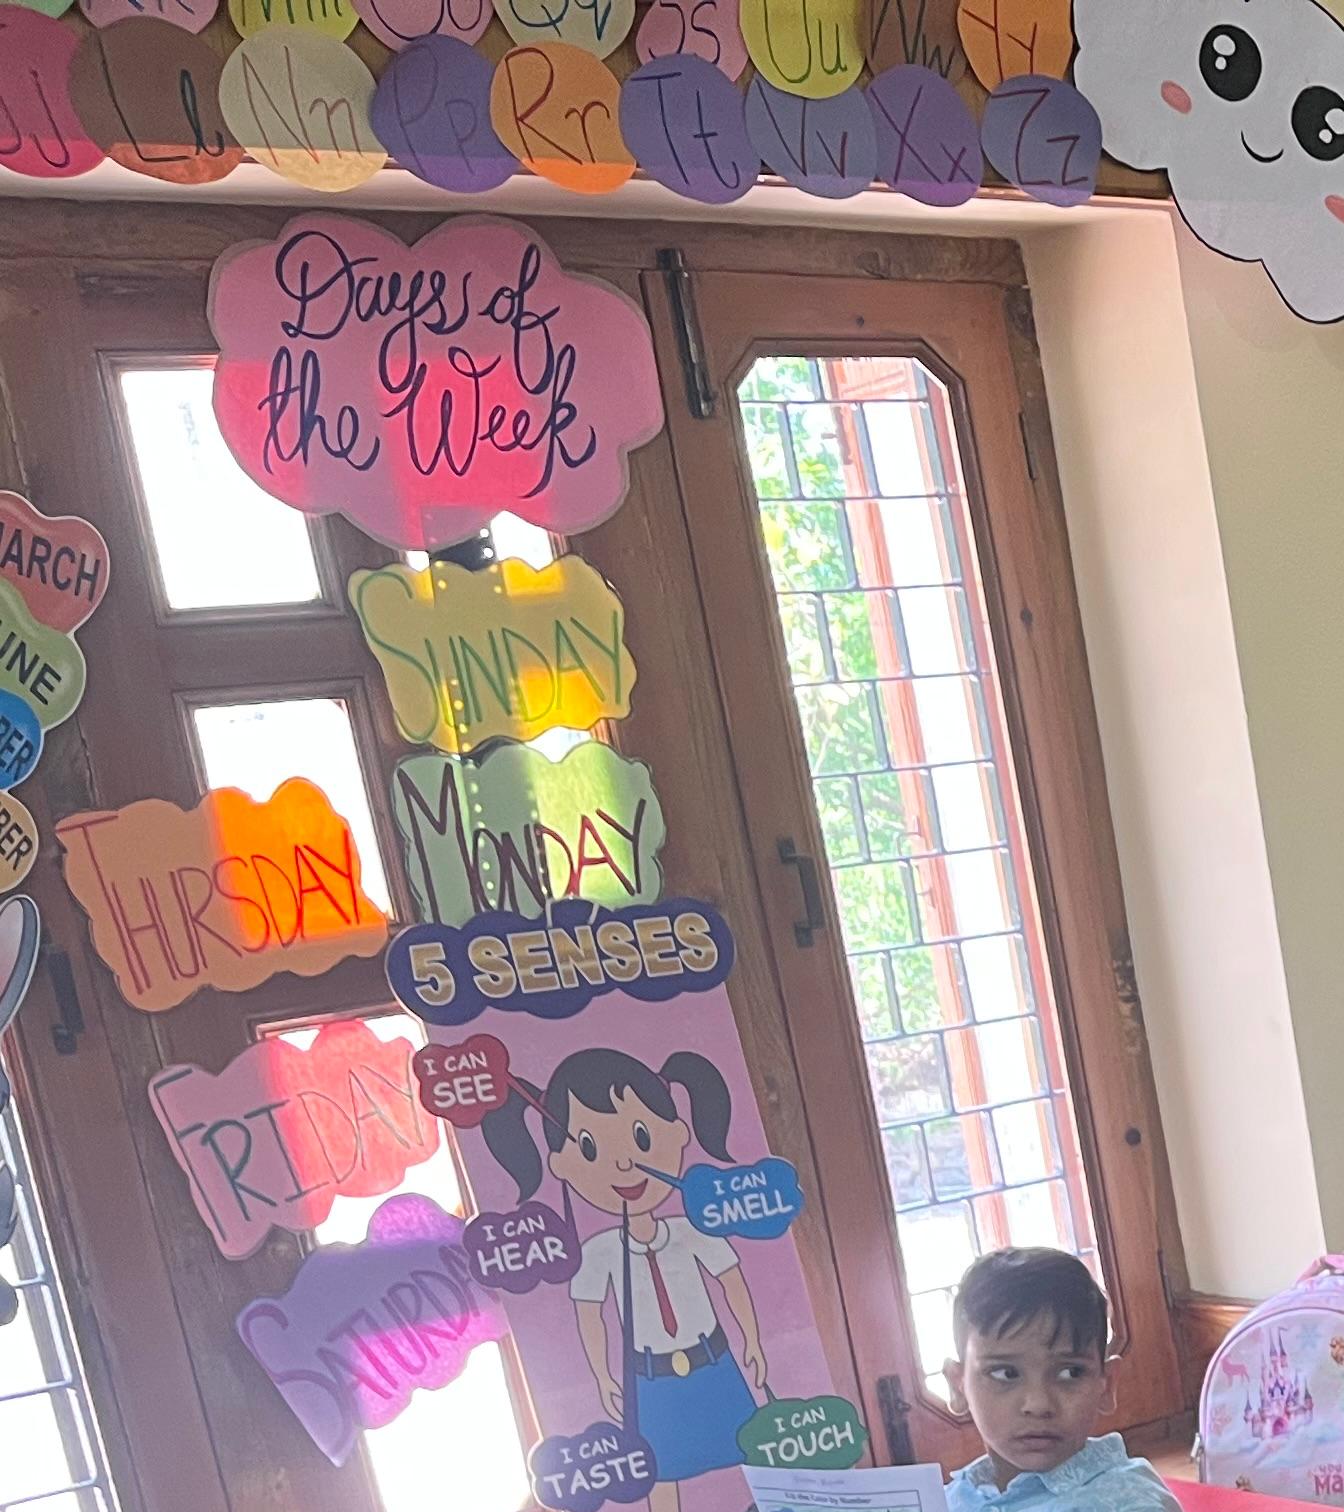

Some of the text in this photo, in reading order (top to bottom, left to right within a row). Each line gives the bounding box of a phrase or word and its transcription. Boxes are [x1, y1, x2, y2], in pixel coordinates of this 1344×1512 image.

[764, 0, 847, 83] Uu
[241, 45, 363, 166] Nn
[393, 46, 477, 177] Pp
[505, 47, 610, 165] Rr
[631, 71, 740, 190] Tt
[753, 78, 847, 179] Vv
[870, 85, 975, 185] Xx
[991, 88, 1088, 186] Zz
[275, 231, 560, 394] Days of
[258, 343, 596, 500] the Week
[356, 572, 624, 743] SUNDAY
[398, 763, 646, 925] MONDAY
[56, 815, 360, 995] THURSDAY
[408, 912, 718, 1006] 5 SENSES
[423, 1051, 488, 1075] I CAN
[433, 1073, 497, 1108] SEE
[154, 1050, 425, 1243] FRIDAY
[703, 1189, 793, 1228] SMELL
[713, 1171, 767, 1195] I CAN
[477, 1236, 568, 1276] HEAR
[482, 1215, 545, 1241] I CAN
[241, 1244, 500, 1452] SATURDA
[561, 1435, 619, 1464] I CAN
[757, 1421, 854, 1466] TOUCH
[774, 1406, 826, 1433] I CAN
[543, 1450, 649, 1498] TASTE
